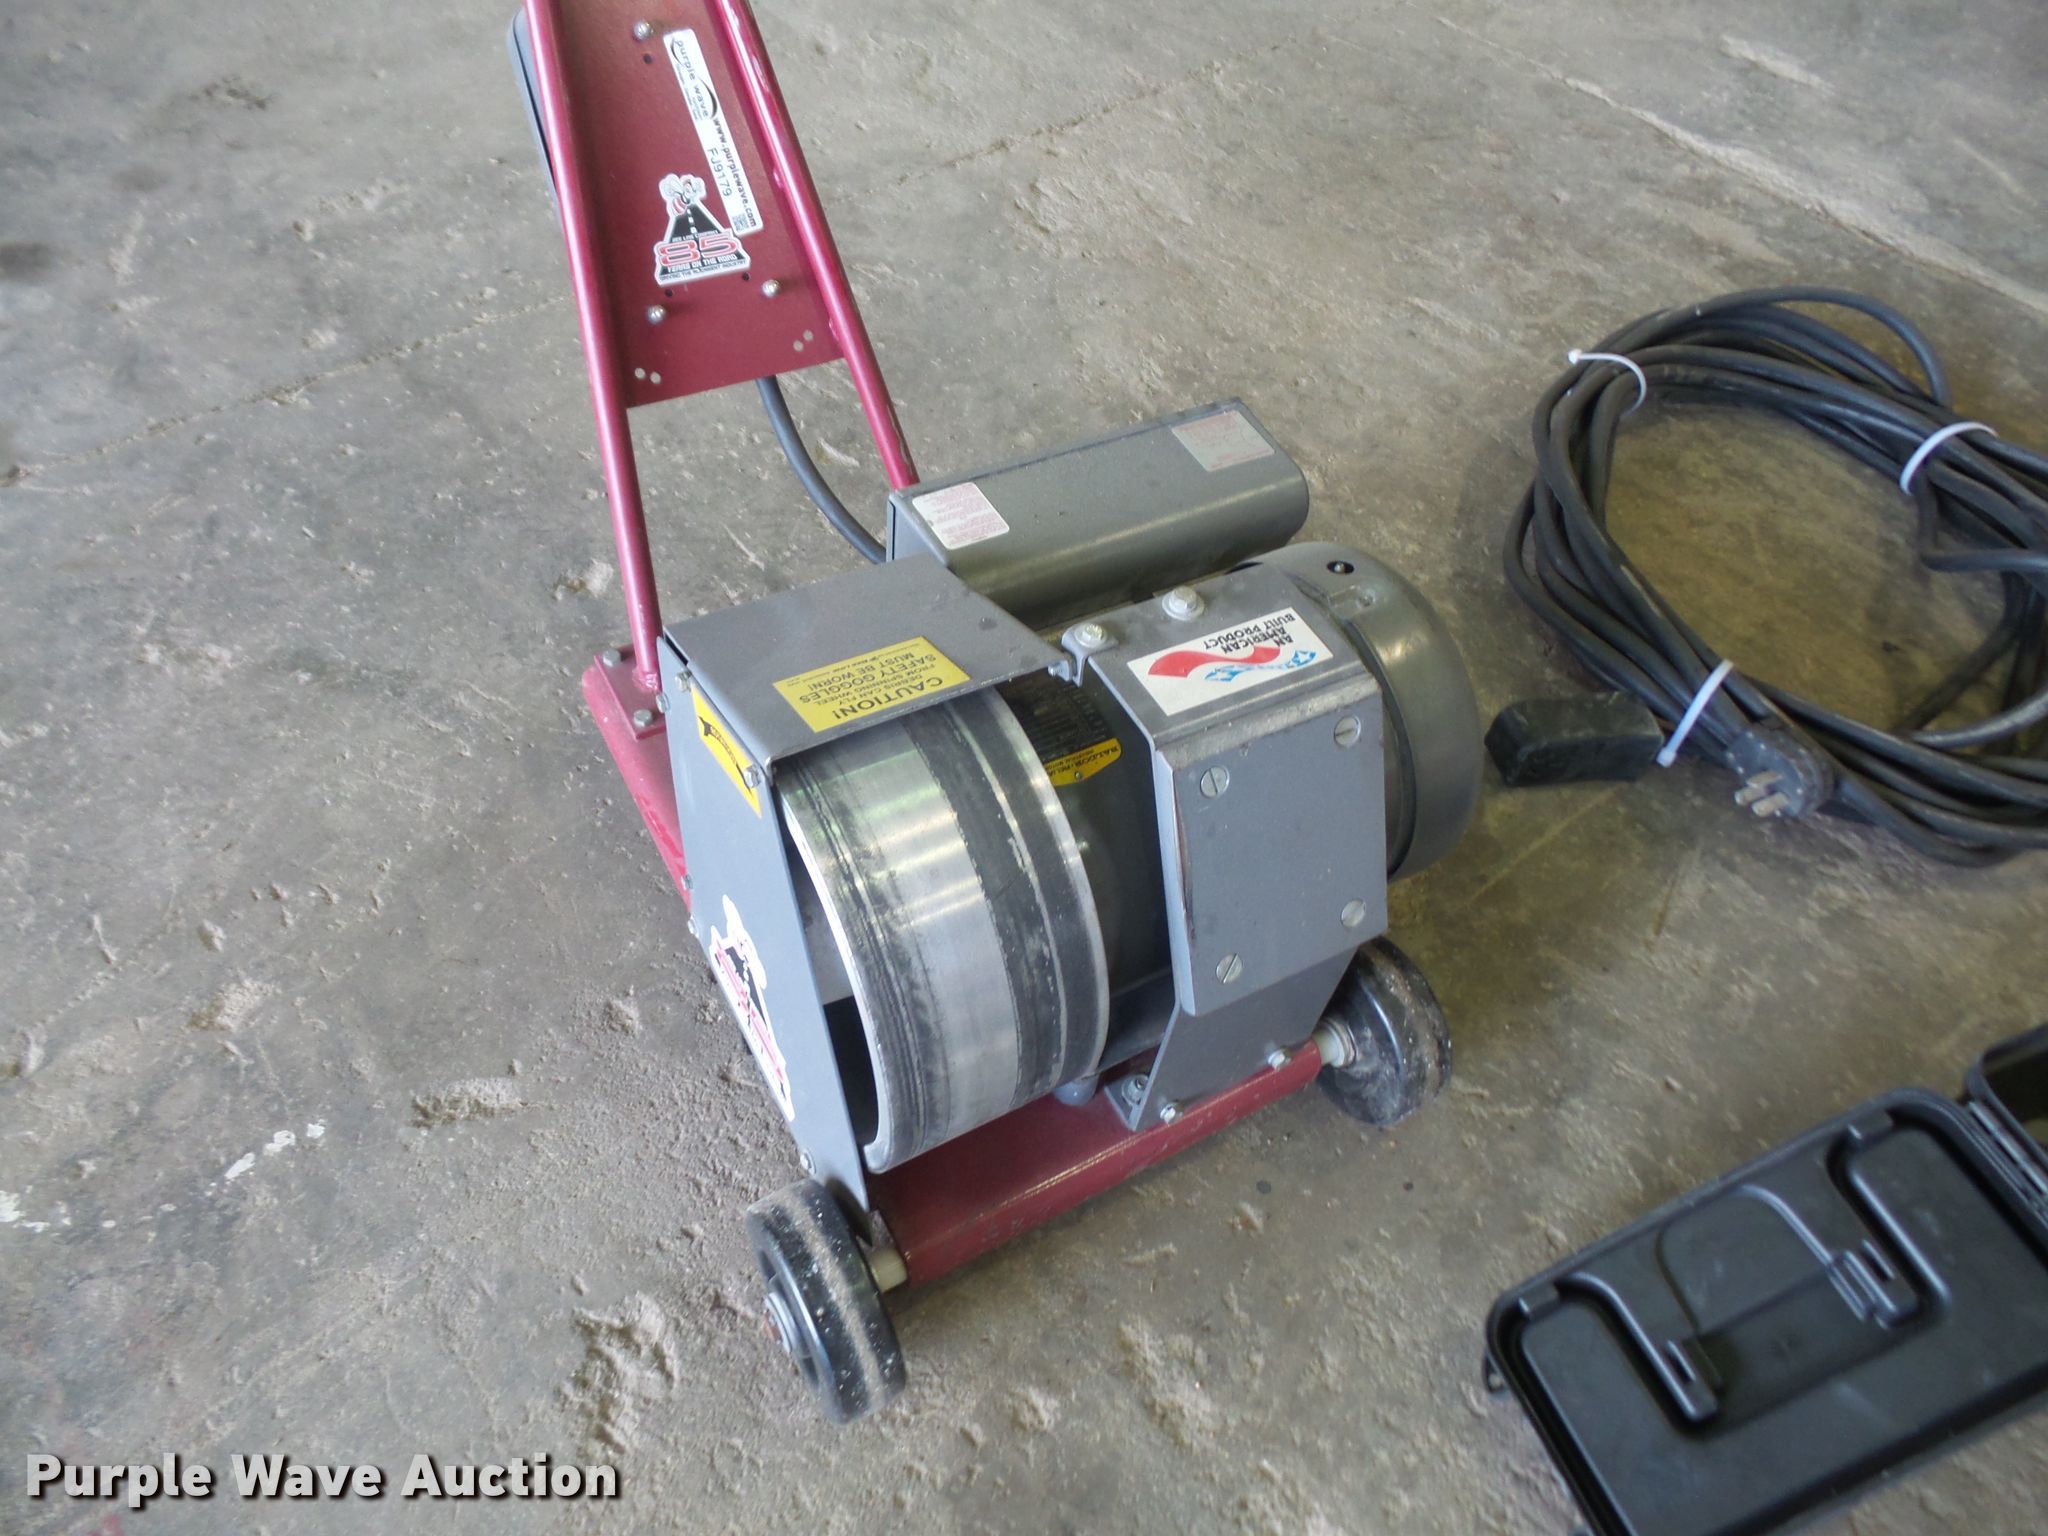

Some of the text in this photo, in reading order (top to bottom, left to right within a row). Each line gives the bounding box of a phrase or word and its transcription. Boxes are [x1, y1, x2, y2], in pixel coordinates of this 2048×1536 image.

[674, 40, 695, 80] purple
[694, 85, 708, 116] wave
[707, 148, 732, 196] FJ9179
[713, 120, 757, 227] www.purplewave.com
[659, 234, 736, 266] 85
[703, 258, 717, 266] THE
[717, 254, 737, 263] ROAD
[1202, 614, 1296, 650] BUILT PRODUCT
[1221, 627, 1287, 654] AMERICAN
[1273, 635, 1294, 646] AN
[857, 665, 874, 675] BE
[878, 652, 914, 668] MUST
[880, 654, 936, 677] SAFETY
[798, 674, 875, 703] GOGGLES
[808, 671, 854, 691] WORN!
[813, 663, 936, 706] FROM SPINNING WHEEL
[838, 675, 922, 706] DEBRIS CAN FLY
[832, 677, 942, 719] CAUTION!
